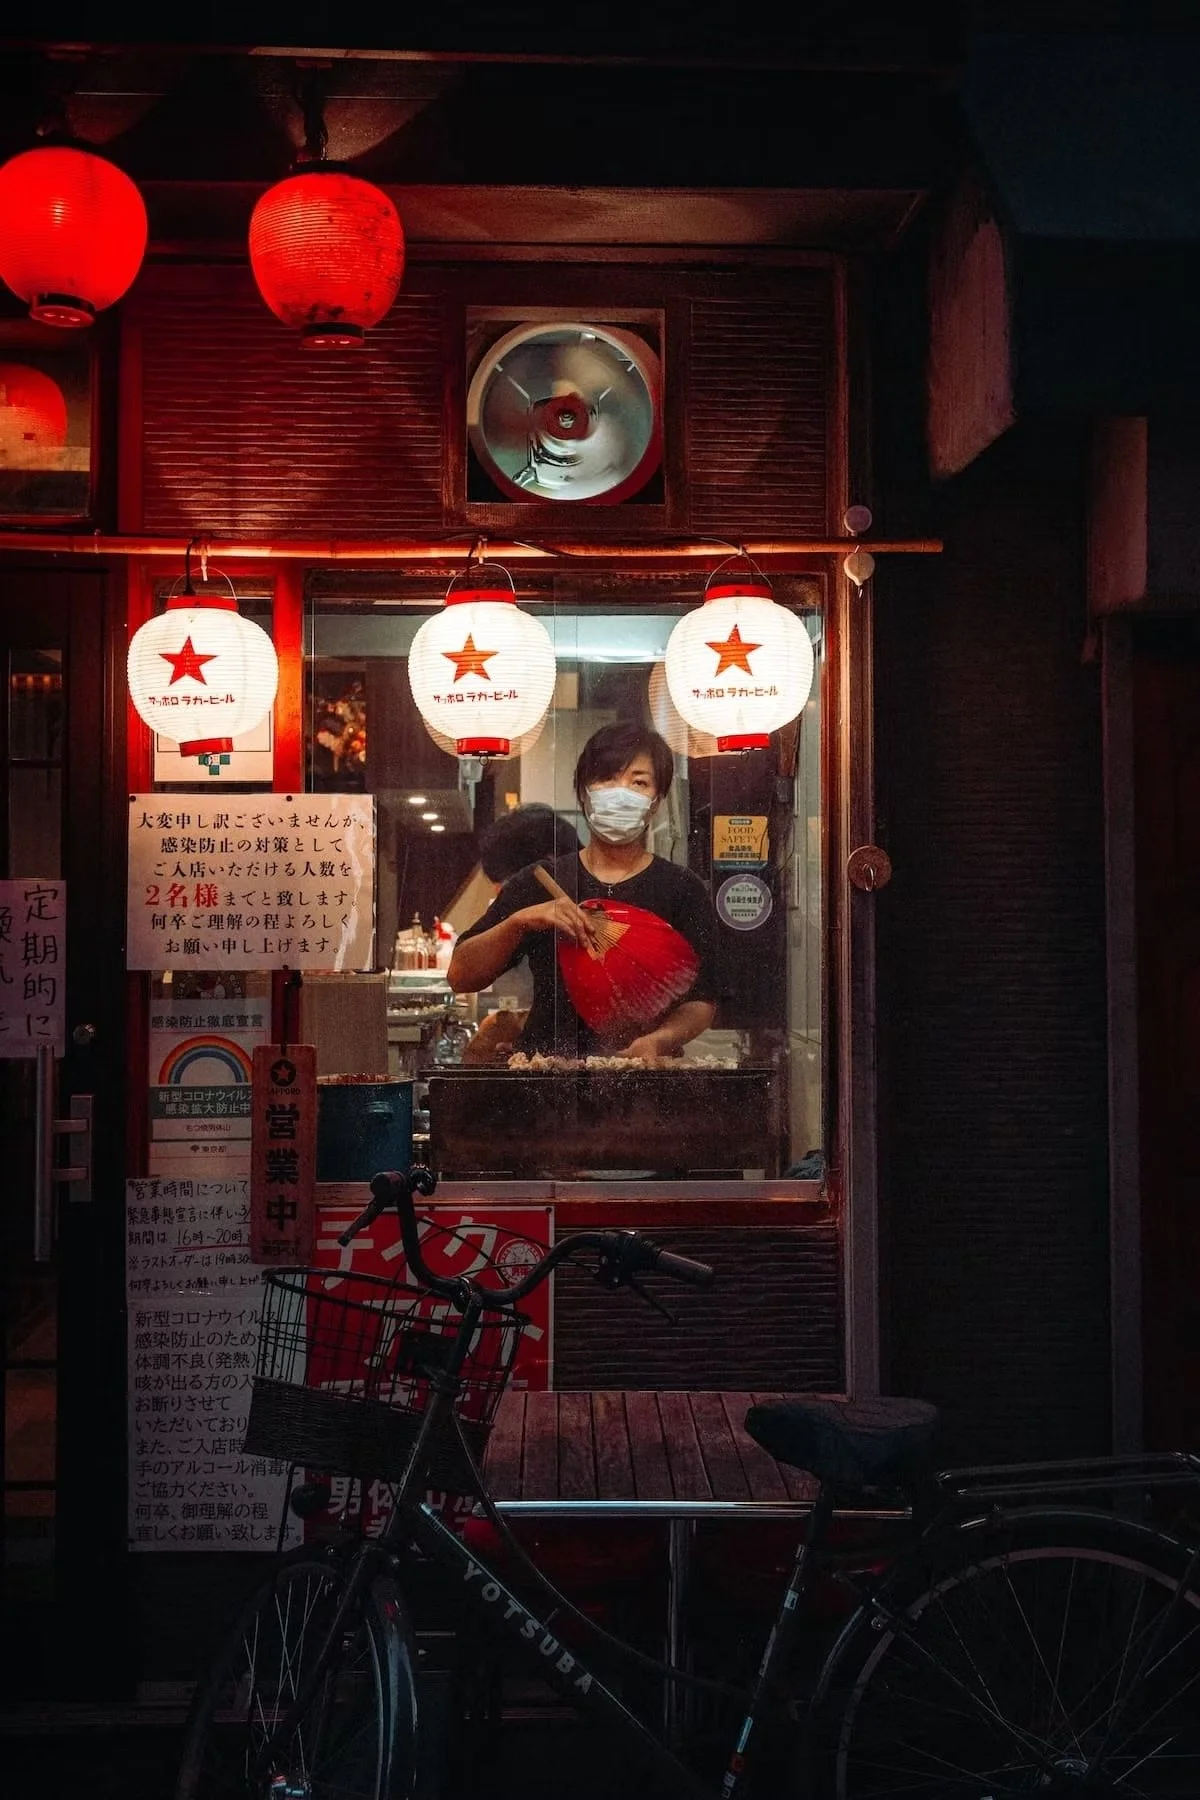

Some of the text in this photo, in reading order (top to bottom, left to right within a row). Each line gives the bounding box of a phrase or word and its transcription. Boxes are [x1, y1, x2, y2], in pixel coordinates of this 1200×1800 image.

[138, 812, 365, 830] 大変申し訳ございませんが、
[727, 826, 754, 834] FOOD
[160, 837, 343, 854] 感染防止の対策として
[153, 861, 352, 878] ご入店いただける人数を
[144, 883, 358, 908] 2名様までと致します。
[151, 914, 351, 930] 何卒ご理解の程よろしく
[165, 938, 340, 955] お願い申し上げます。
[20, 884, 58, 1036] 定期的に
[151, 1014, 264, 1028] 感染防止徹底宣言
[264, 1103, 300, 1231] 営業中
[135, 1309, 278, 1328] 新型コロナウイルス
[135, 1332, 257, 1349] 感染防止のため
[135, 1396, 231, 1412] お断りさせて
[135, 1418, 247, 1433] いただいており
[135, 1481, 253, 1498] ご協力ください。
[135, 1503, 268, 1520] 何卒、御理解の程
[463, 1560, 593, 1695] YOTSUBA
